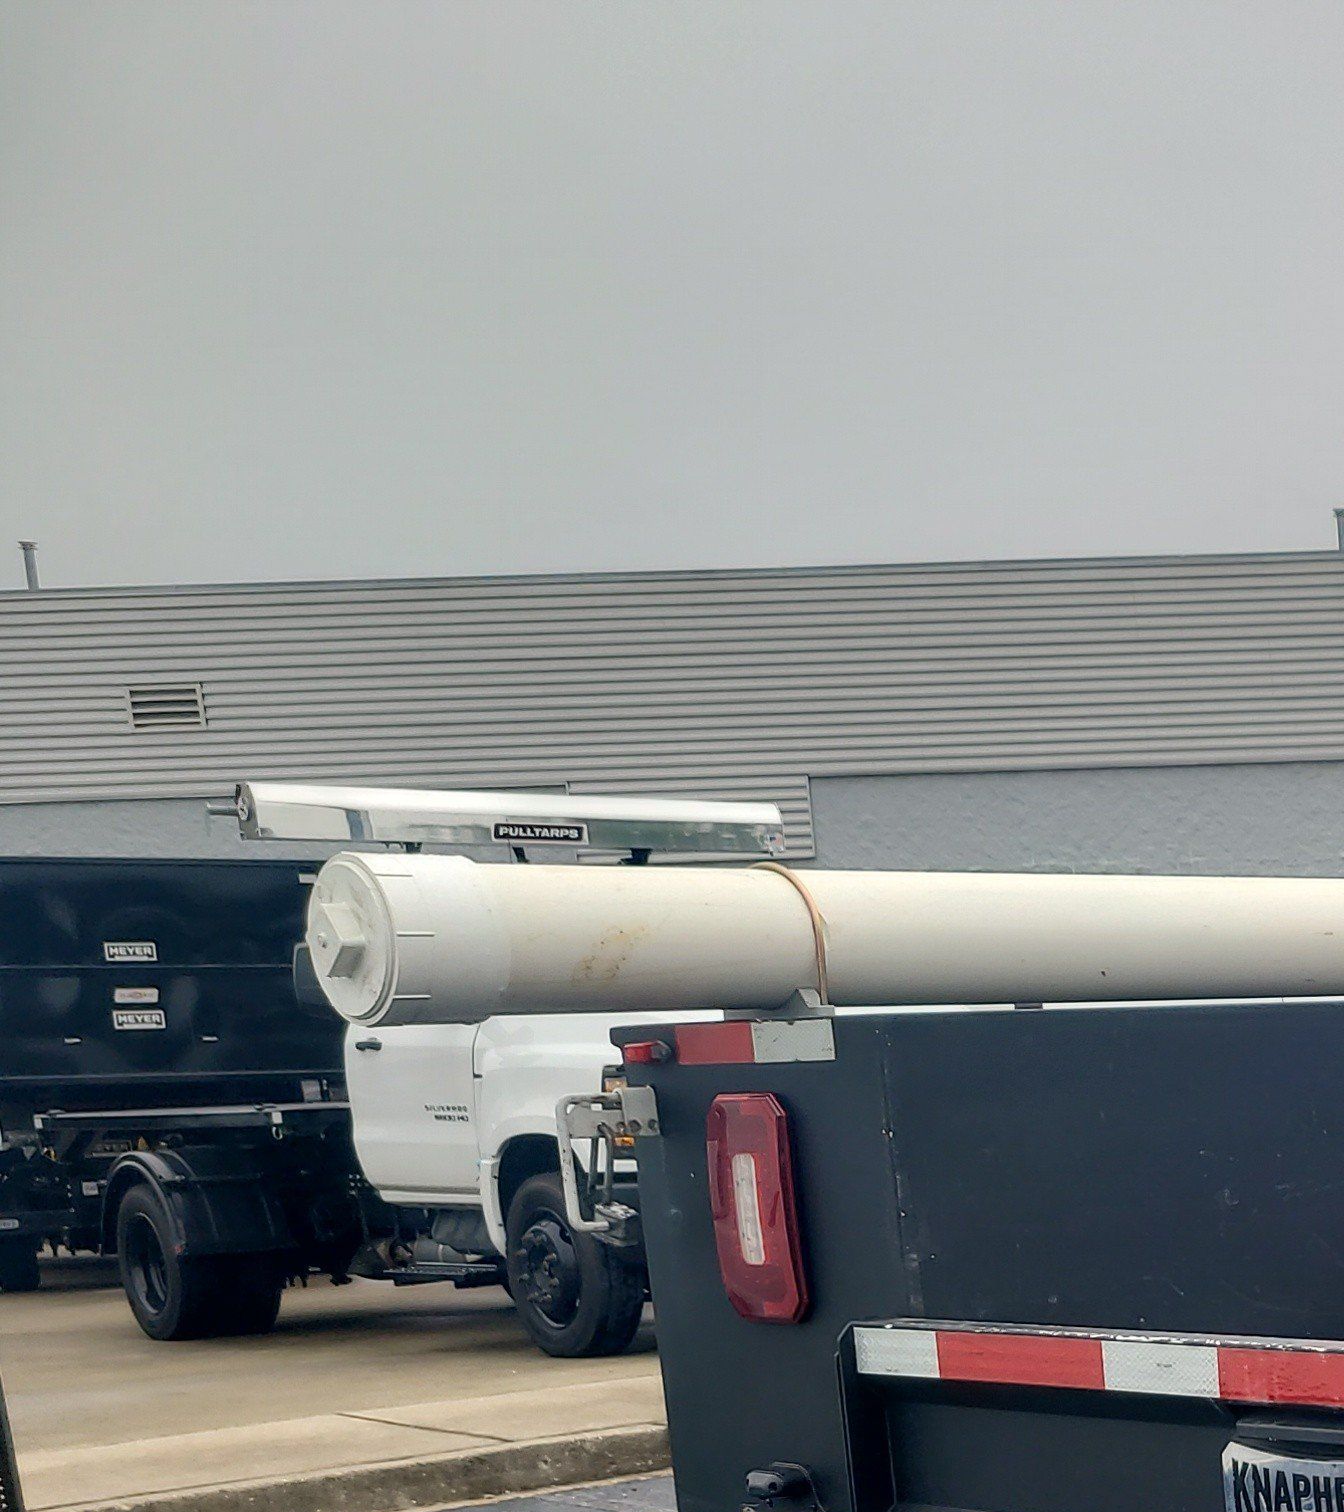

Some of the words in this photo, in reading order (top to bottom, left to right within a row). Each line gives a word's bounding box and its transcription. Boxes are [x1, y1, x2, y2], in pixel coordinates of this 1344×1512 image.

[499, 826, 579, 840] PULLTARPS
[109, 945, 152, 956] MEYER
[118, 1013, 161, 1024] MEYER
